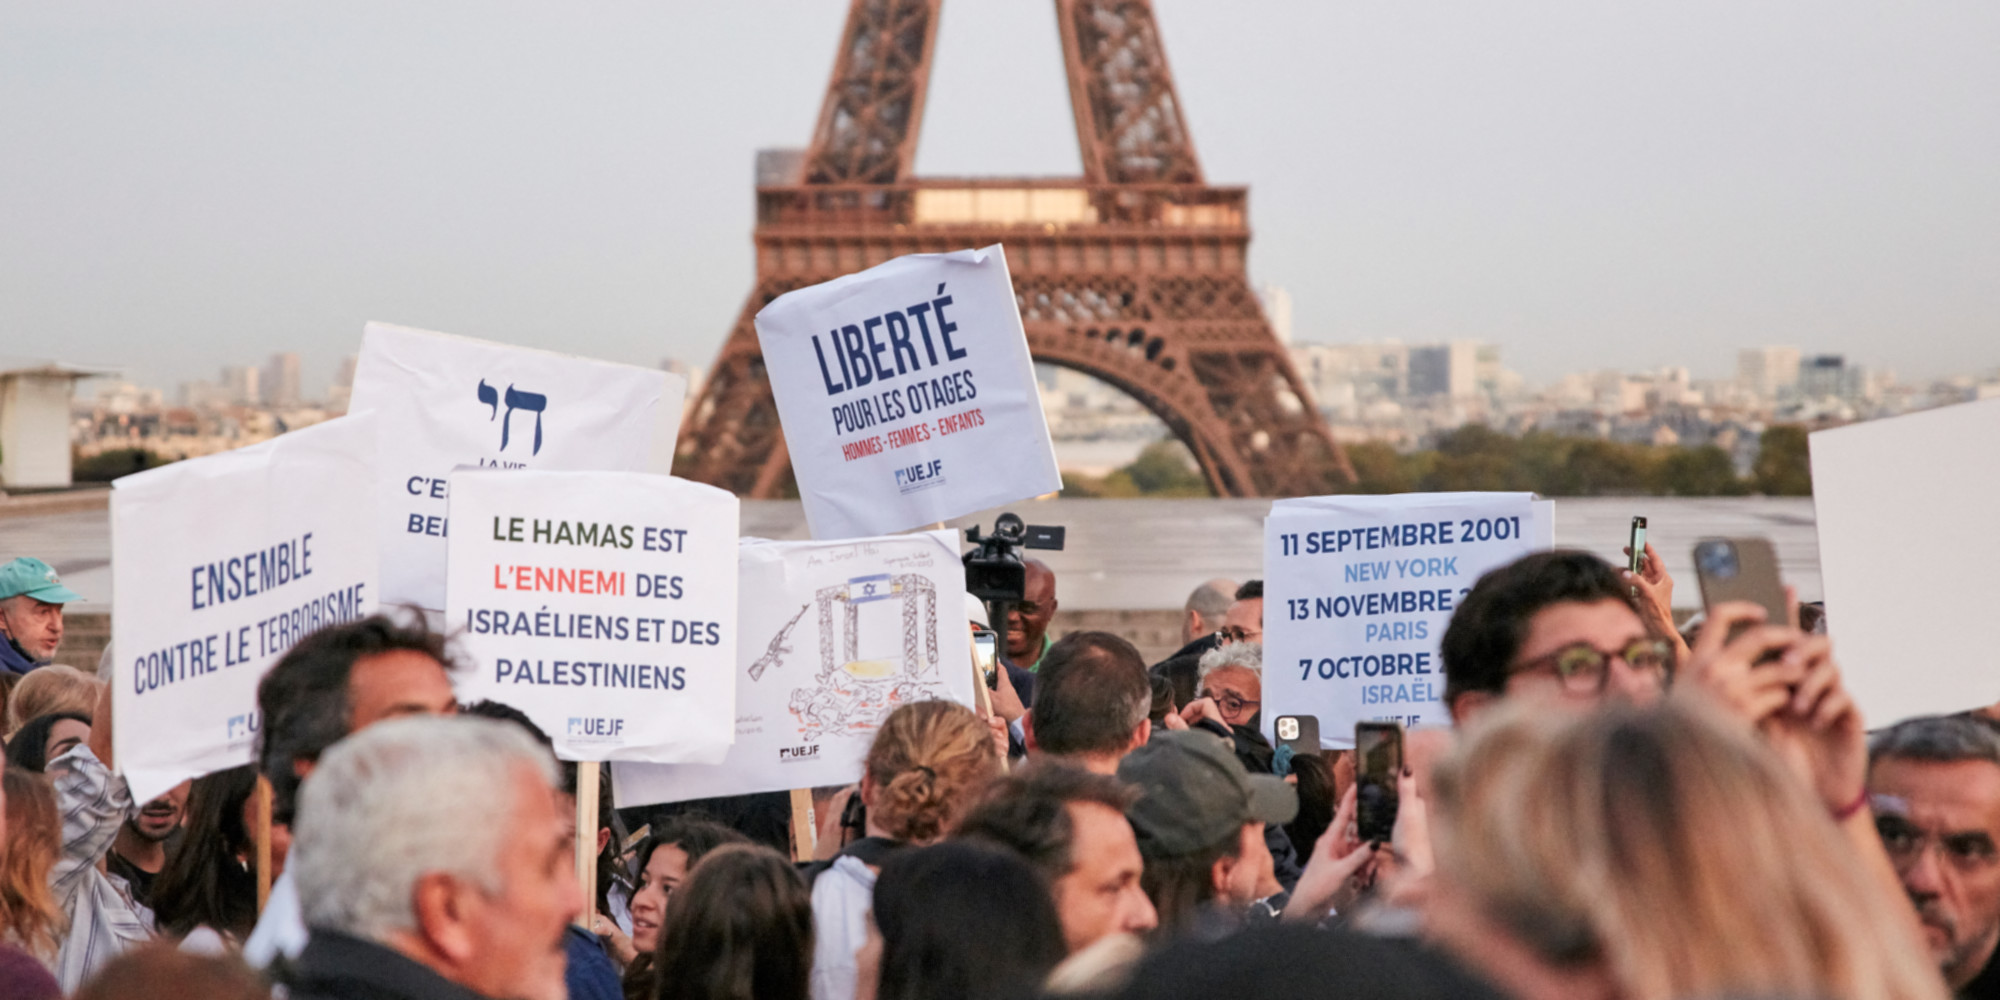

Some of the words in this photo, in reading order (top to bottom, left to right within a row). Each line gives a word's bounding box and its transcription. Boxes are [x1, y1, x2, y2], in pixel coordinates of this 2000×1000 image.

[811, 282, 967, 395] LIBERTÉ
[477, 378, 547, 457] חי
[832, 398, 876, 436] POUR
[873, 389, 906, 424] LES
[906, 369, 977, 414] OTAGES
[842, 435, 883, 461] HOMMES
[887, 423, 930, 449] FEMMES
[937, 408, 985, 436] ENFANTS
[406, 476, 449, 499] C'E
[906, 459, 942, 482] UEJF
[493, 516, 524, 542] LE
[533, 519, 634, 549] HAMAS
[643, 526, 688, 553] EST
[1280, 533, 1299, 556] 11
[1305, 521, 1454, 554] SEPTEMBRE
[1460, 516, 1520, 543] 2001
[192, 532, 312, 610] ENSEMBLE
[494, 564, 626, 597] L'ENNEMI
[636, 573, 683, 600] DES
[1344, 560, 1391, 584] NEW
[1395, 556, 1459, 579] YORK
[1287, 598, 1309, 620] 13
[1316, 589, 1453, 619] NOVEMBRE
[134, 635, 218, 695] CONTRE
[225, 626, 250, 667] LE
[257, 583, 364, 657] TERRORISME
[467, 605, 629, 641] ISRAÉLIENS
[636, 618, 665, 642] ET
[671, 620, 720, 646] DES
[1366, 620, 1428, 643] PARIS
[496, 658, 686, 690] PALESTINIENS
[1299, 659, 1313, 681] 7
[1318, 652, 1431, 680] OCTOBRE
[1362, 677, 1439, 705] ISRAËL
[584, 717, 624, 736] UEJF
[791, 744, 819, 757] UEJF
